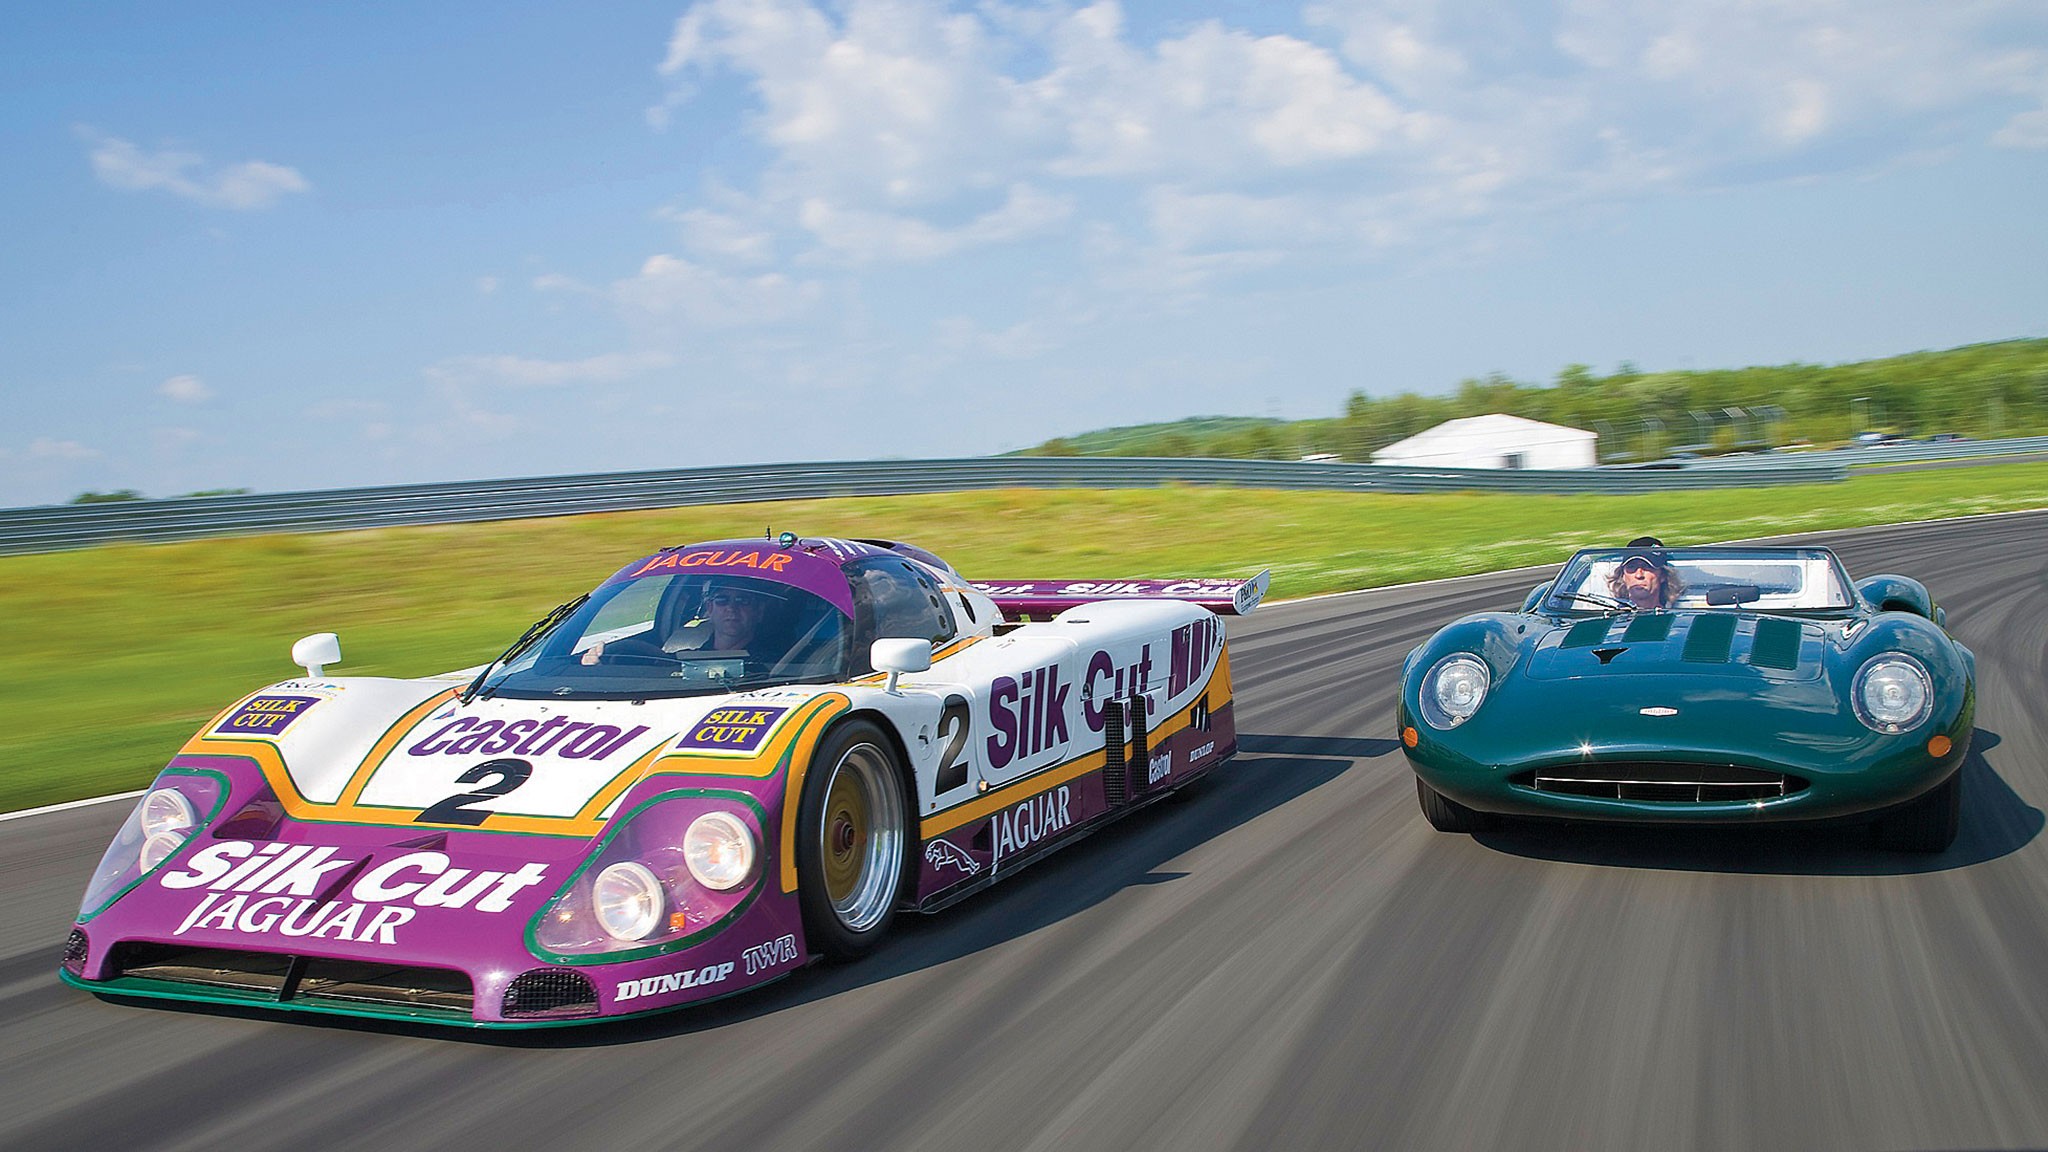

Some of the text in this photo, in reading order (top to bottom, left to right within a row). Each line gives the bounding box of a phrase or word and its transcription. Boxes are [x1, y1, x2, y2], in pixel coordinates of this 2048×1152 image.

[631, 551, 793, 578] JAGUAR
[1057, 582, 1150, 595] Silk
[232, 713, 287, 728] CUT
[244, 699, 307, 713] SILK
[703, 710, 774, 725] SILK
[986, 643, 1155, 770] Silk Cut
[408, 716, 651, 761] Castrol
[695, 726, 757, 743] CUT
[935, 694, 970, 797] 2
[413, 758, 533, 826] 2
[990, 785, 1072, 876] JAGUAR
[160, 840, 550, 912] Silk Cut
[173, 892, 417, 945] JAGUAR
[742, 933, 798, 975] TWR
[614, 961, 735, 1002] DUNLOP
